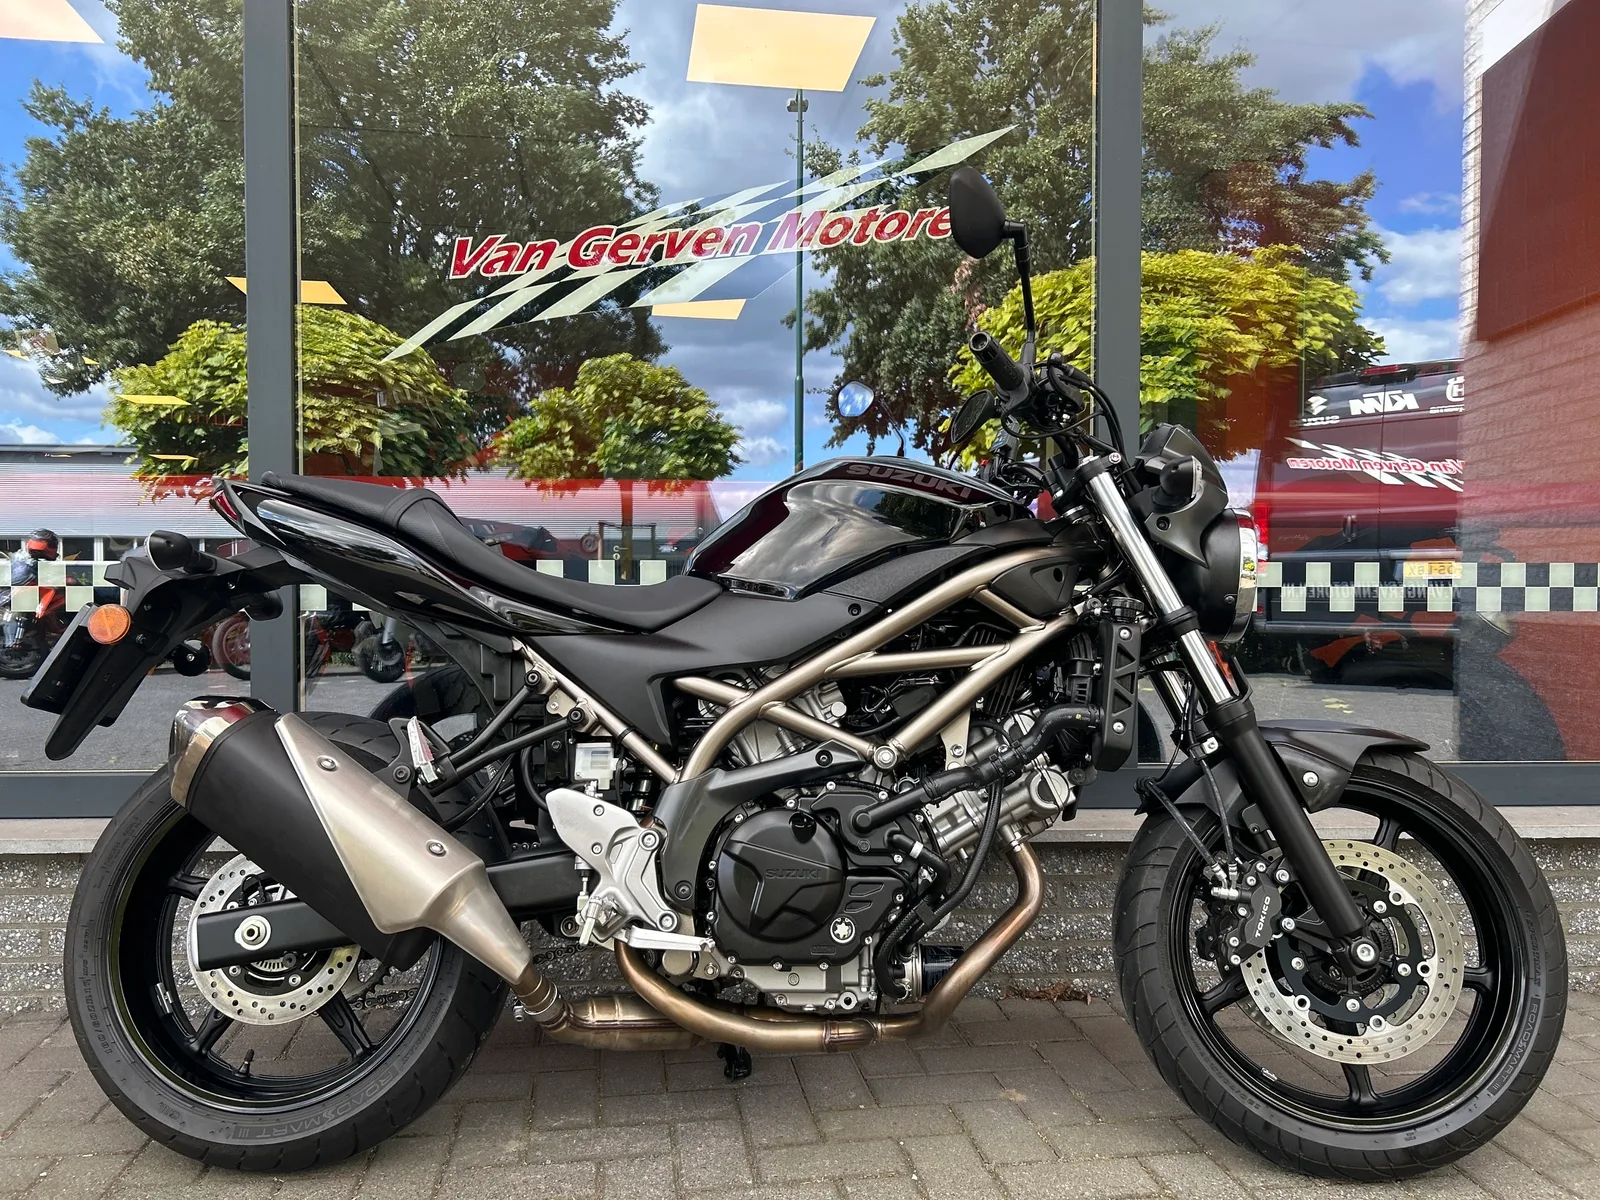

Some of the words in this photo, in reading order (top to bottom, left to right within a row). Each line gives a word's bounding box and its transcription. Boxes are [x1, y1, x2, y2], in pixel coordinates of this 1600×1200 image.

[449, 234, 559, 280] Van
[565, 221, 763, 269] Gerven
[767, 203, 953, 253] Motore
[846, 464, 972, 499] SUZUKI
[765, 868, 822, 880] SUZUKI
[1254, 896, 1271, 938] TOKICO
[1501, 1003, 1538, 1083] ROADSMART
[256, 1069, 394, 1139] ROADSMART
